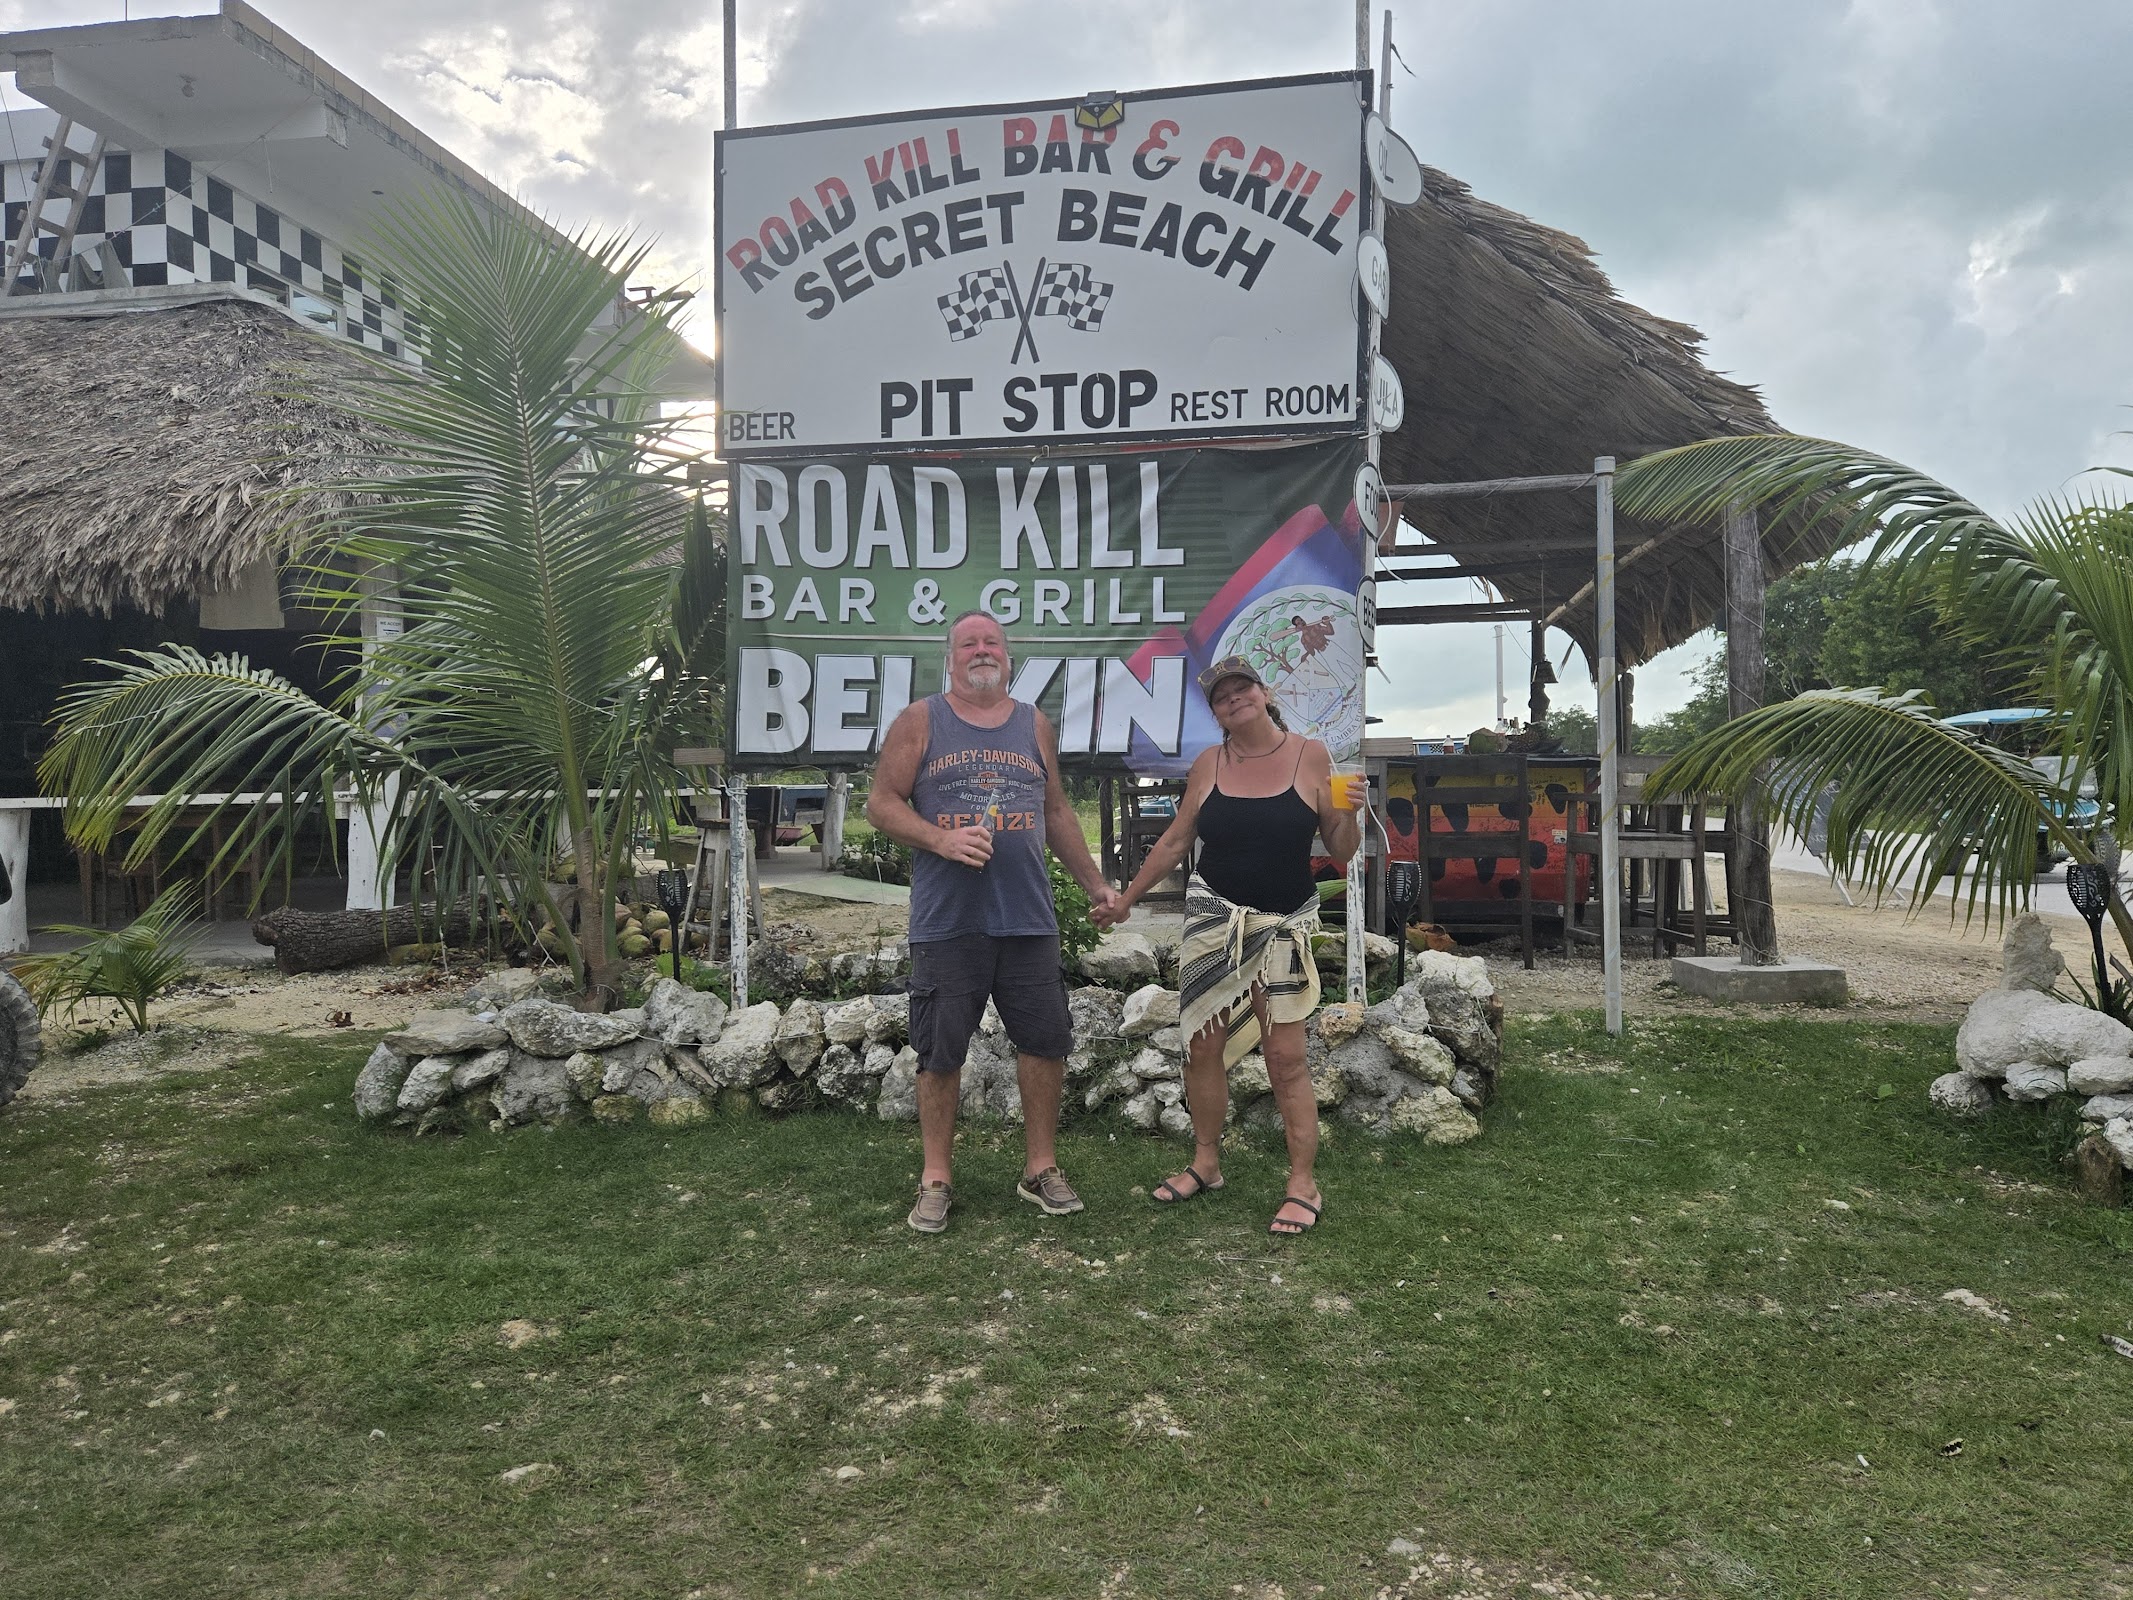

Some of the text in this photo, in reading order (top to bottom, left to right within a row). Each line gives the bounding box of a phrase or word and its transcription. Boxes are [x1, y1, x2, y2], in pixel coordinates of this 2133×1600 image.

[726, 115, 1356, 295] ROAD KILL BAR & GRILL
[794, 188, 1276, 320] SECRET BEACH
[881, 369, 1350, 439] PIT STOP REST ROOM
[729, 412, 796, 442] BEER
[740, 461, 1185, 569] ROAD KILL
[742, 575, 1186, 625] BAR & GRILL
[1330, 724, 1359, 743] UMBRA
[928, 749, 1042, 778] HARLEY-DAVIDSON
[958, 763, 1016, 773] LEGENDARY
[938, 783, 952, 792] LIVE
[951, 779, 968, 789] FREE
[959, 791, 1017, 803] MOTORLES
